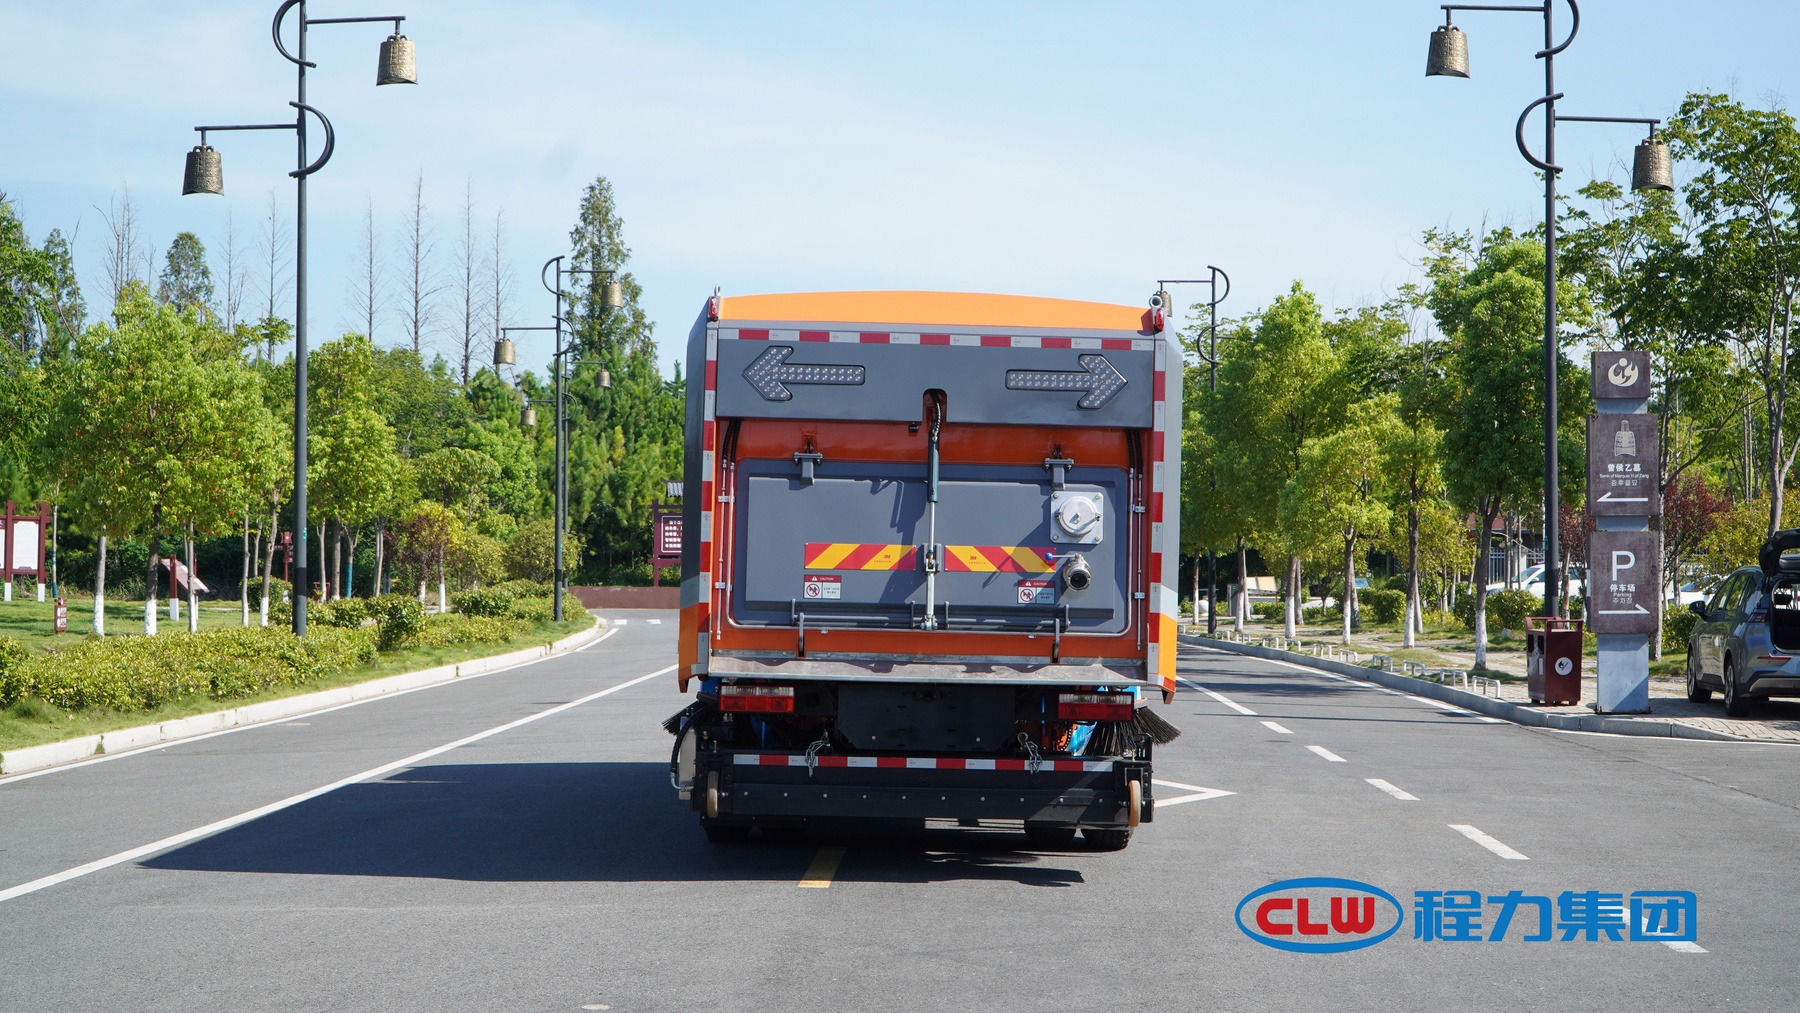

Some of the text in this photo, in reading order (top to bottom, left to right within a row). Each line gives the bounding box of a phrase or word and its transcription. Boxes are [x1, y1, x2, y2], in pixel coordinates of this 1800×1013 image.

[1607, 463, 1641, 472] 曾侯乙墓
[1612, 550, 1636, 581] P
[1610, 583, 1636, 592] 停车场
